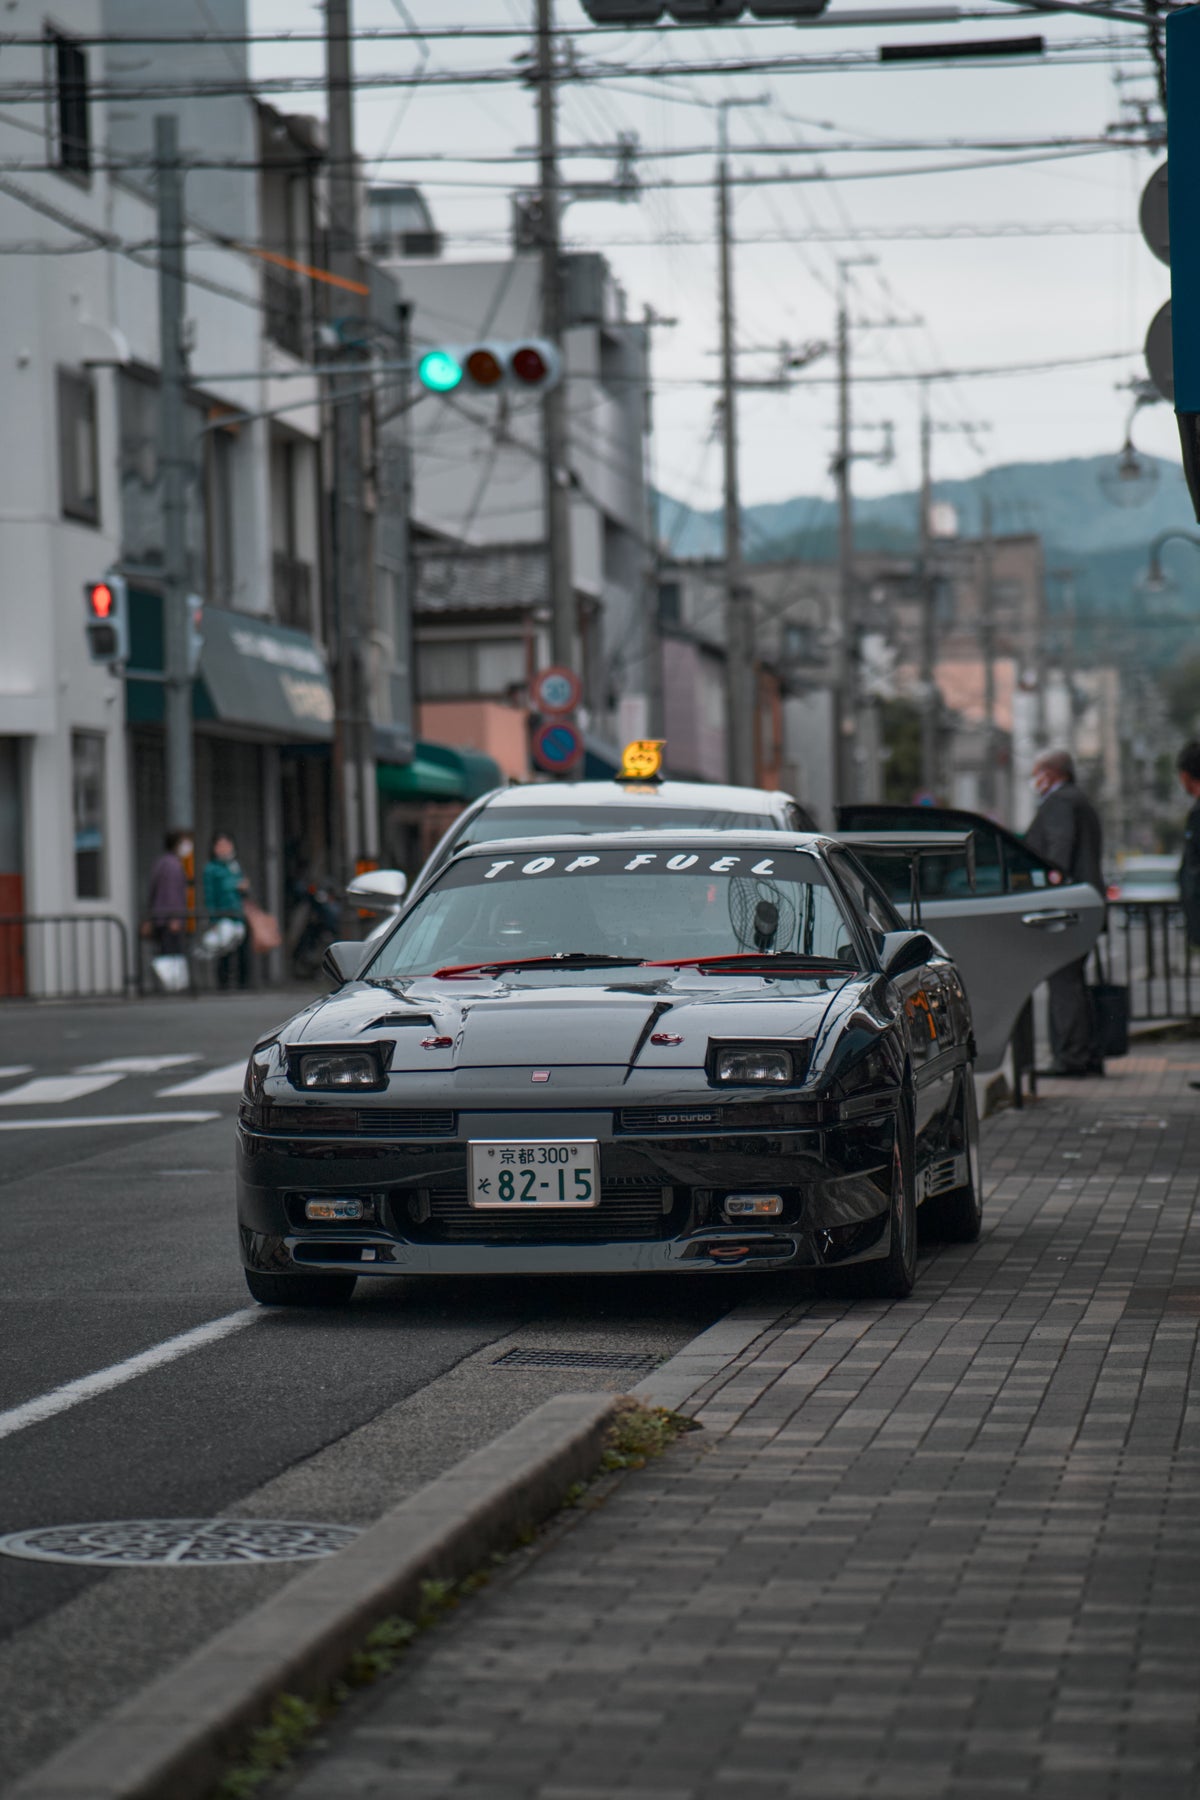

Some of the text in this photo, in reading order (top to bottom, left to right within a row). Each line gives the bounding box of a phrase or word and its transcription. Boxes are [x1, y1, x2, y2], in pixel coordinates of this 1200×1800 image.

[484, 853, 775, 878] TOP FUEL
[657, 1113, 712, 1123] 3.0 turbo
[498, 1168, 592, 1202] 82-15
